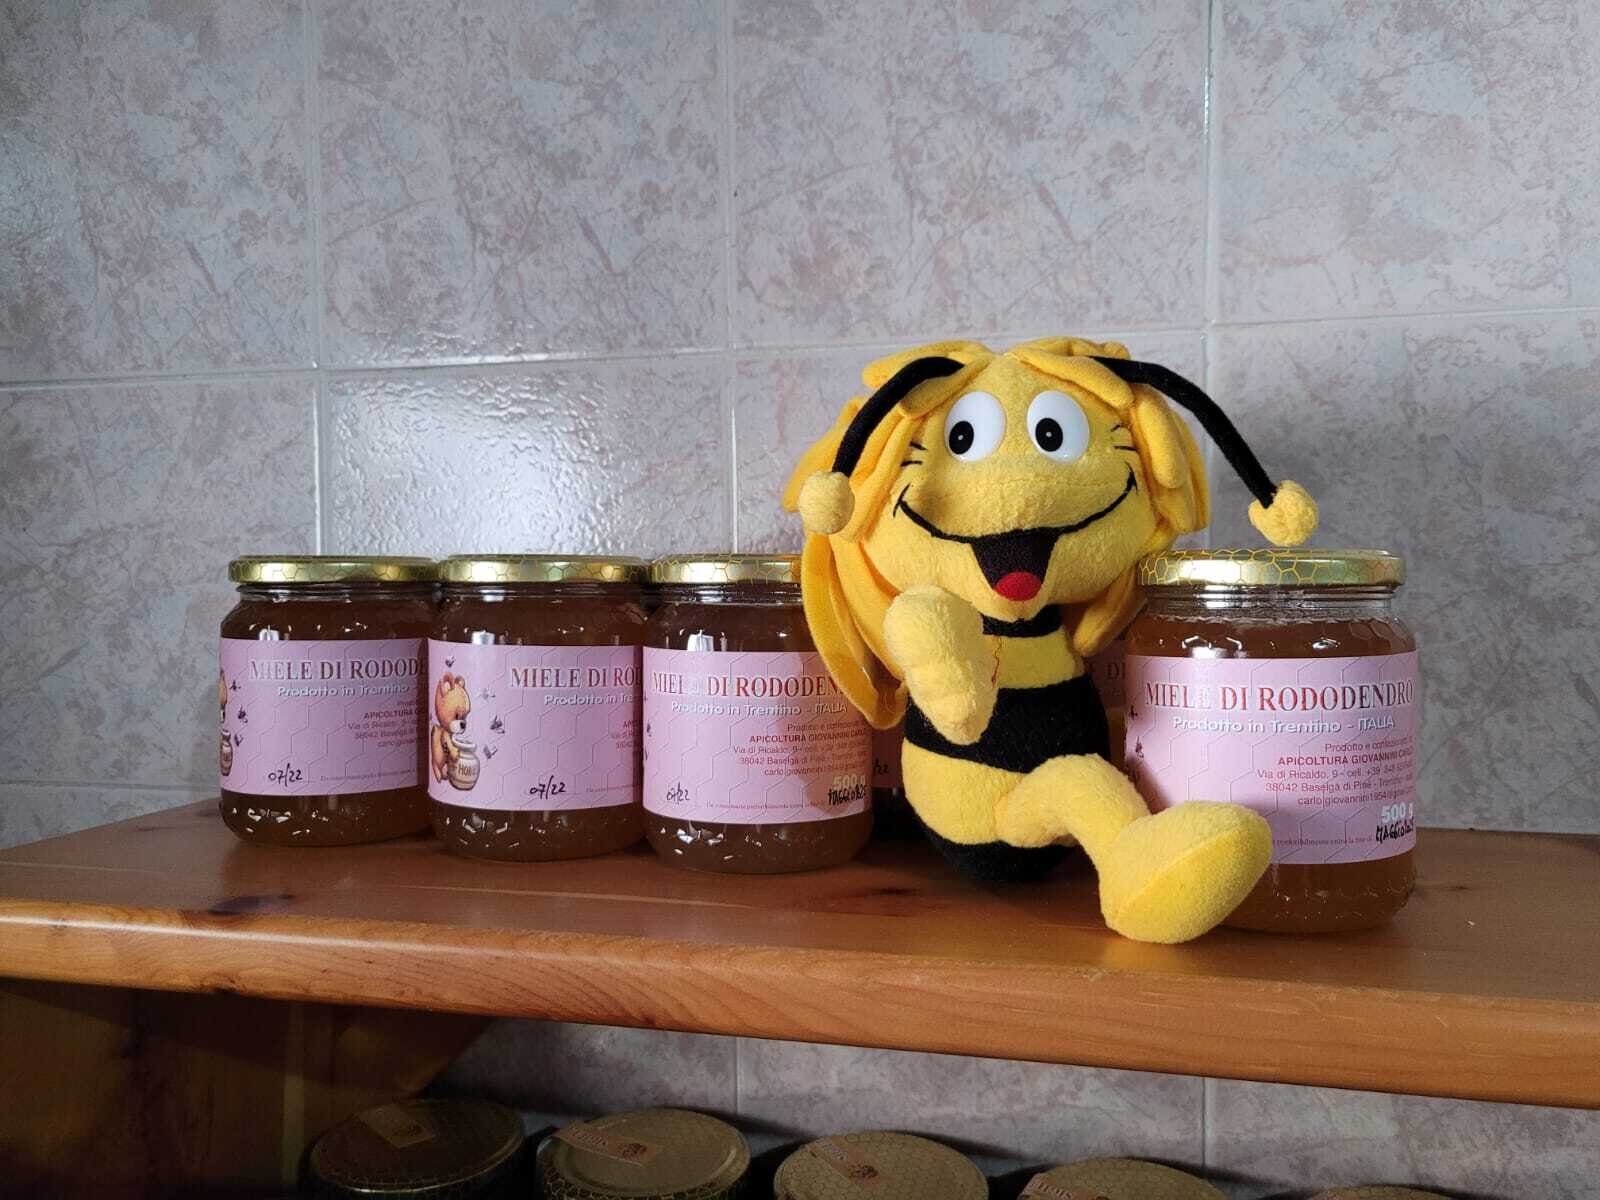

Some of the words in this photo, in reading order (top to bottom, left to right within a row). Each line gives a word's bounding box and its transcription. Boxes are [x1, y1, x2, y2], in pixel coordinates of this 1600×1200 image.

[249, 660, 313, 680] MIELE
[320, 660, 342, 680] DI
[350, 657, 420, 679] RODOD
[511, 667, 581, 688] MIELE
[588, 667, 607, 687] DI
[652, 671, 700, 695] MIEL
[707, 676, 728, 697] DI
[736, 677, 845, 699] RODODEN
[278, 686, 338, 698] Prodotto
[342, 686, 356, 697] in
[544, 695, 603, 706] Prodotto
[605, 694, 617, 705] in
[1145, 681, 1212, 710] MIELE
[1221, 686, 1247, 711] DI
[1258, 679, 1414, 711] RODODENDRO
[671, 700, 724, 716] Prodotto
[728, 703, 742, 716] in
[745, 703, 802, 716] Trentino
[815, 702, 848, 714] ITALIA
[1172, 716, 1243, 732] Prodotto
[1248, 717, 1266, 732] in
[1270, 717, 1342, 733] Trentino
[1358, 716, 1396, 730] ITALIA
[750, 734, 807, 743] APICOLTURA
[1324, 743, 1363, 752] Prodotto
[1277, 755, 1349, 766] APICOLTURA
[1351, 752, 1398, 765] GIOVANNINI
[267, 762, 304, 788] 07/22
[1256, 769, 1274, 779] Via
[1276, 769, 1286, 779] di
[1331, 770, 1338, 778] 9
[529, 775, 567, 800] 07/22
[1264, 782, 1298, 792] 38042
[1300, 782, 1341, 794] Baselga
[1342, 780, 1352, 791] di
[1381, 802, 1407, 823] 500
